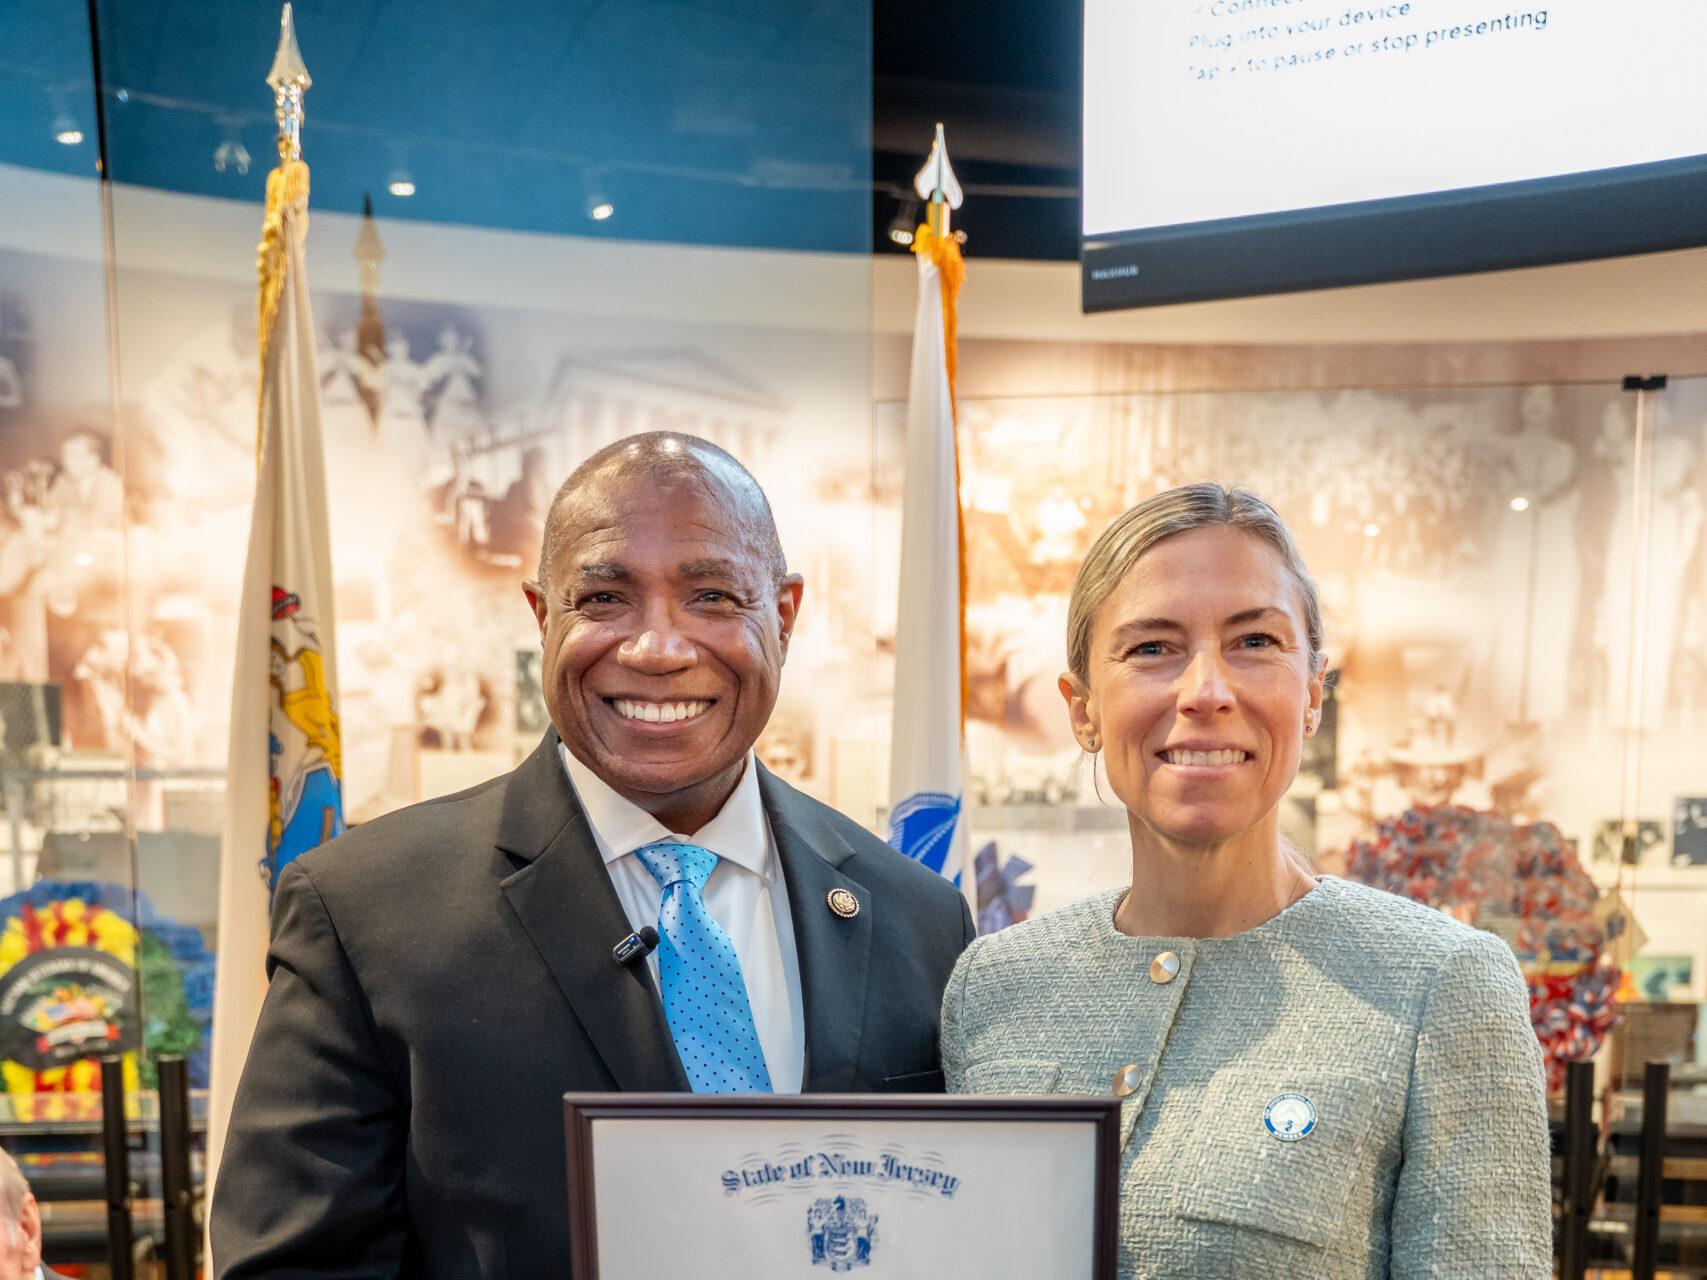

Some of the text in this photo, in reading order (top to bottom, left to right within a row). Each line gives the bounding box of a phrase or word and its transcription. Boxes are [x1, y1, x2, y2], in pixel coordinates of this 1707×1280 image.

[1338, 2, 1412, 27] device
[1273, 47, 1336, 71] pause
[1343, 43, 1363, 58] or
[1371, 33, 1419, 53] stop
[1425, 9, 1548, 50] presenting
[720, 1152, 962, 1200] State of New Jersey
